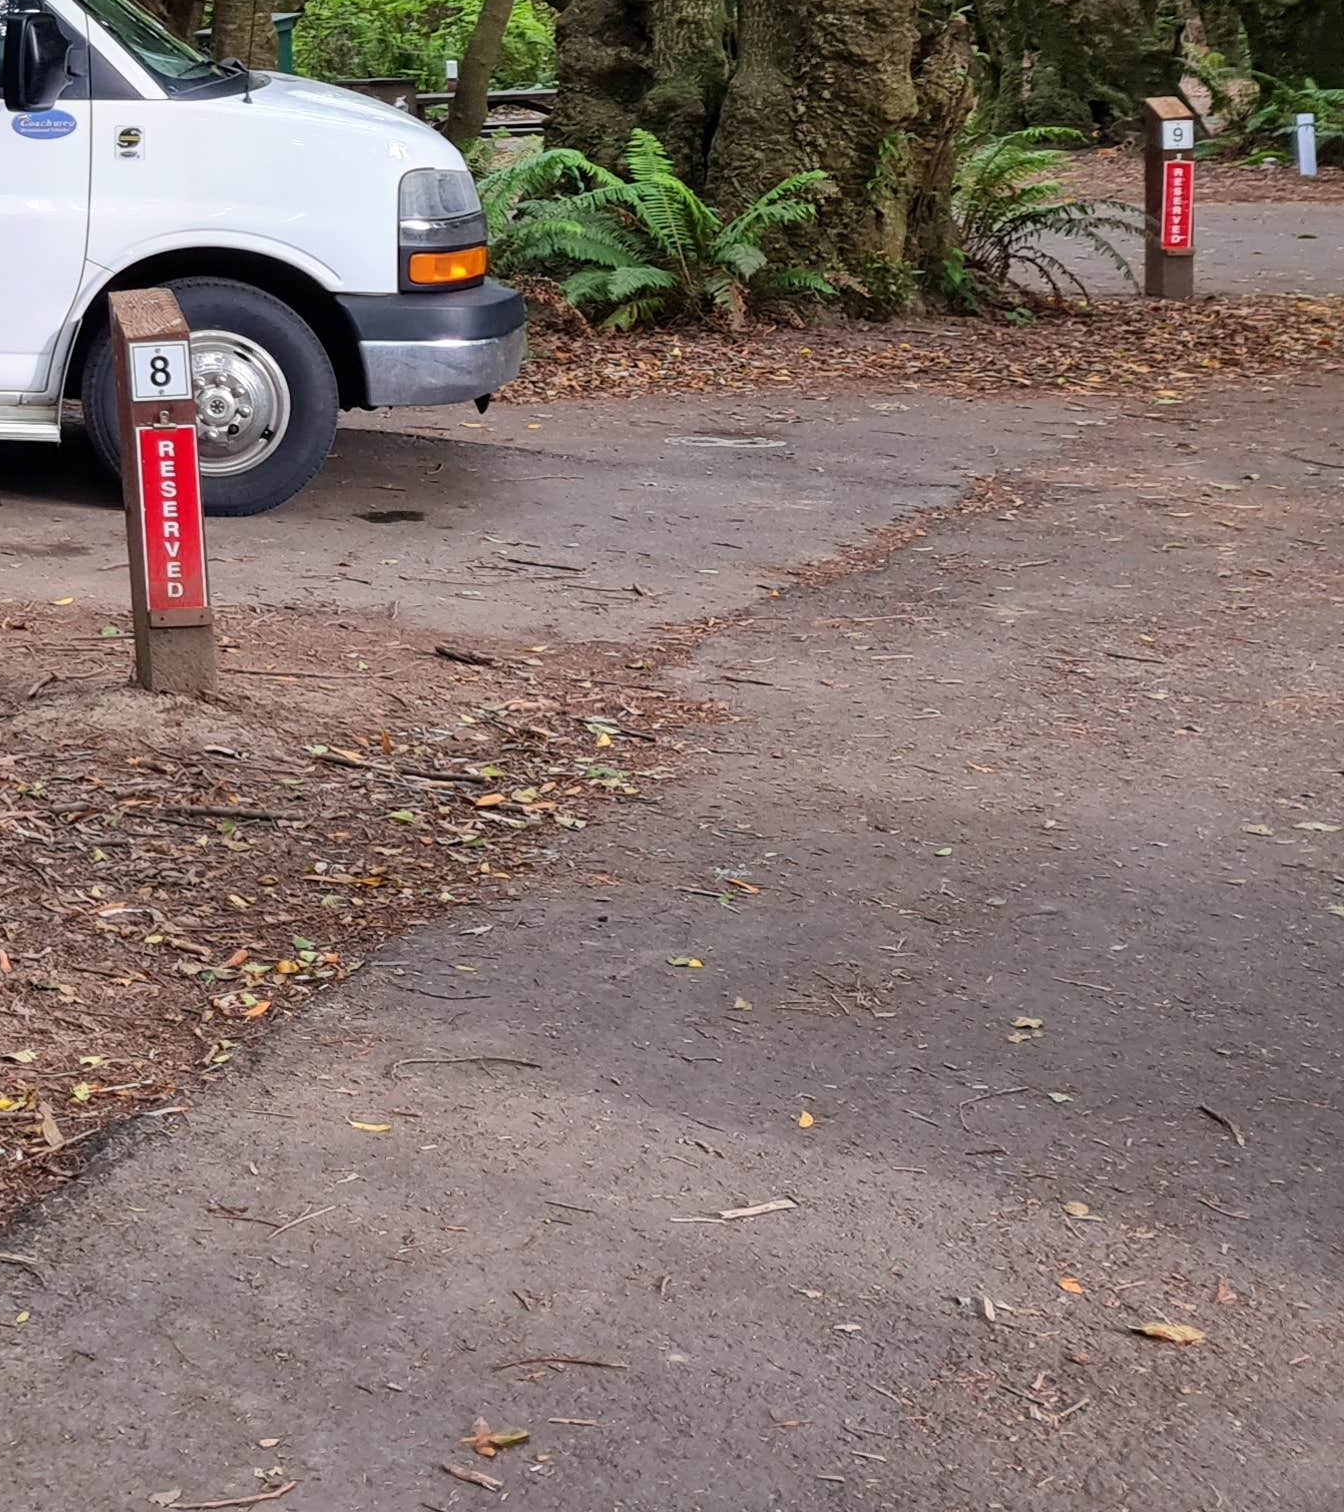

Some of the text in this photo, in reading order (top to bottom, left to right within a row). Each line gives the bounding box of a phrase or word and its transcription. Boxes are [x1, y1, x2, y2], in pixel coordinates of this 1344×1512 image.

[1172, 127, 1184, 142] 9
[1171, 167, 1184, 244] RESERVED
[150, 355, 172, 387] 8
[158, 440, 185, 599] RESERVED
